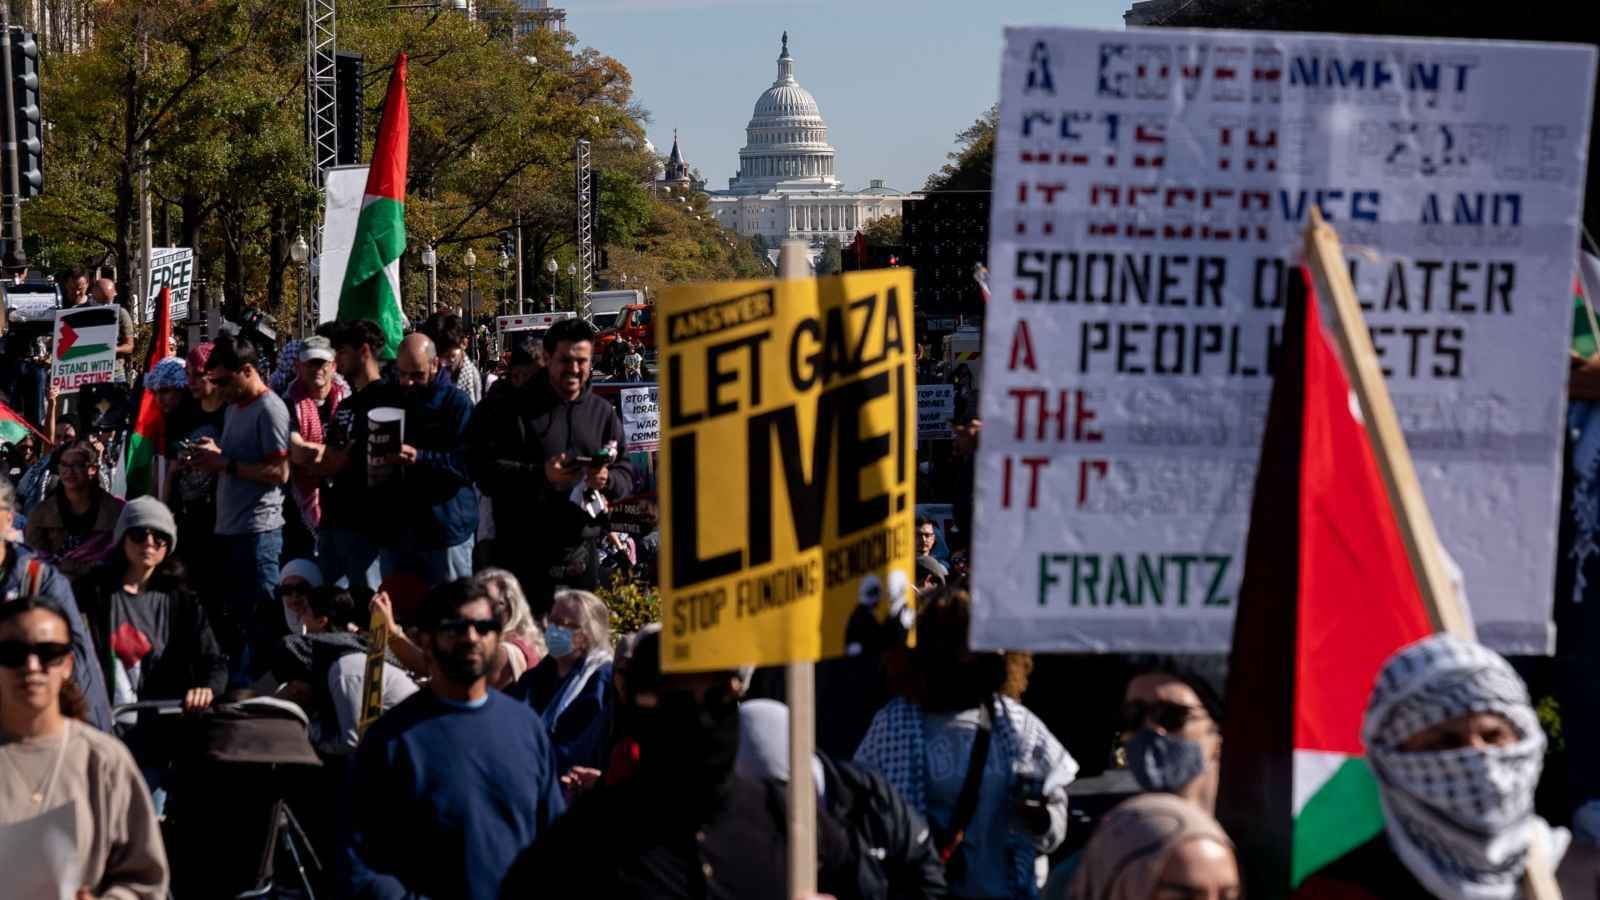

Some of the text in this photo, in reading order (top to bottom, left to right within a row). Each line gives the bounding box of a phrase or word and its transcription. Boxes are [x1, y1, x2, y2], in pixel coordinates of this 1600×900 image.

[1024, 41, 1476, 107] A GOVERNMENT
[1016, 182, 1067, 236] IT
[1421, 191, 1523, 246] AND
[149, 259, 191, 297] FREE
[1013, 250, 1227, 307] SOONER
[1349, 259, 1516, 315] LATER
[673, 295, 771, 339] ANSWER
[58, 361, 88, 375] STAND
[91, 359, 113, 371] WITH
[668, 285, 904, 429] LET GAZA
[1008, 319, 1038, 372] A
[1367, 325, 1465, 379] ETS
[53, 371, 112, 390] PALESTINE
[625, 393, 649, 404] STOP
[631, 431, 662, 442] CRIME
[637, 420, 658, 429] WAR
[1007, 387, 1104, 441] THE
[670, 362, 906, 590] LIVE!
[1001, 456, 1050, 510] IT
[672, 586, 726, 638] STOP
[736, 557, 818, 619] FUNDING
[1037, 553, 1233, 607] FRANTZ
